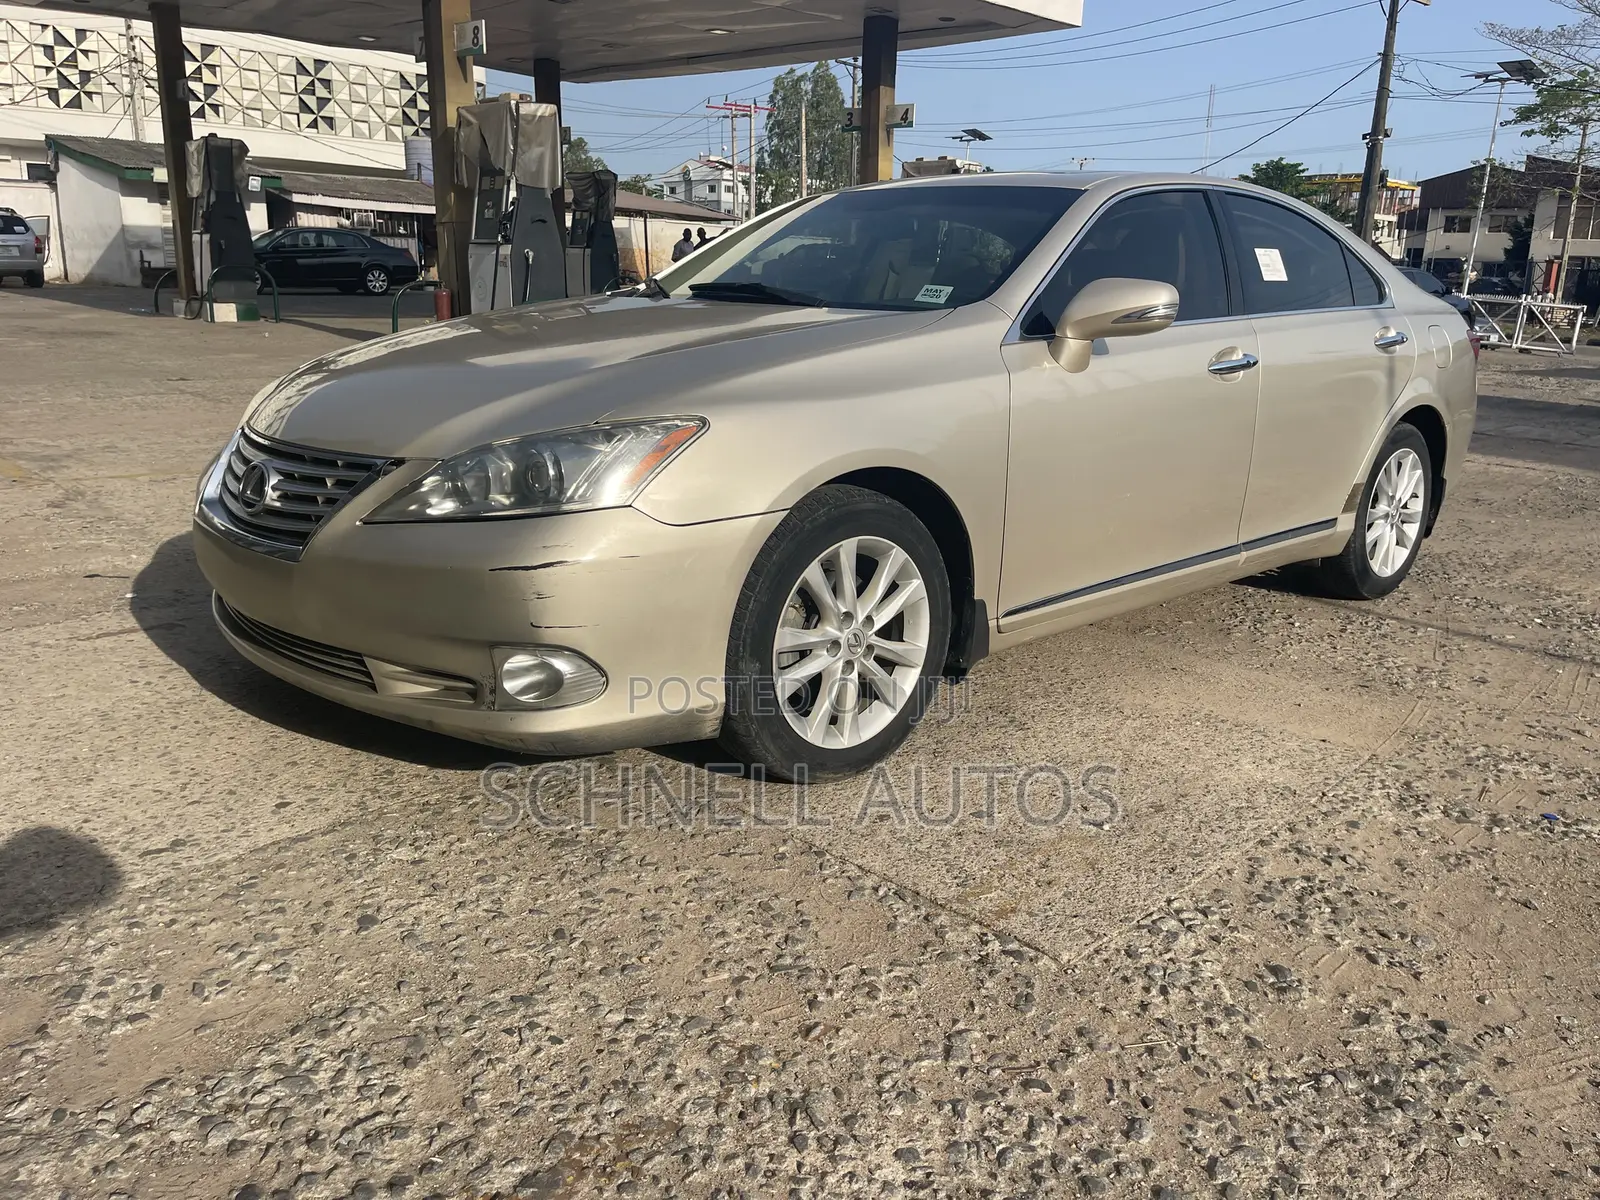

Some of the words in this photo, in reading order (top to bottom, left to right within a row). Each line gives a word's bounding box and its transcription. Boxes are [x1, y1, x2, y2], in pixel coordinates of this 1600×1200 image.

[471, 25, 480, 48] 8
[845, 111, 854, 128] 3
[900, 108, 910, 124] 4
